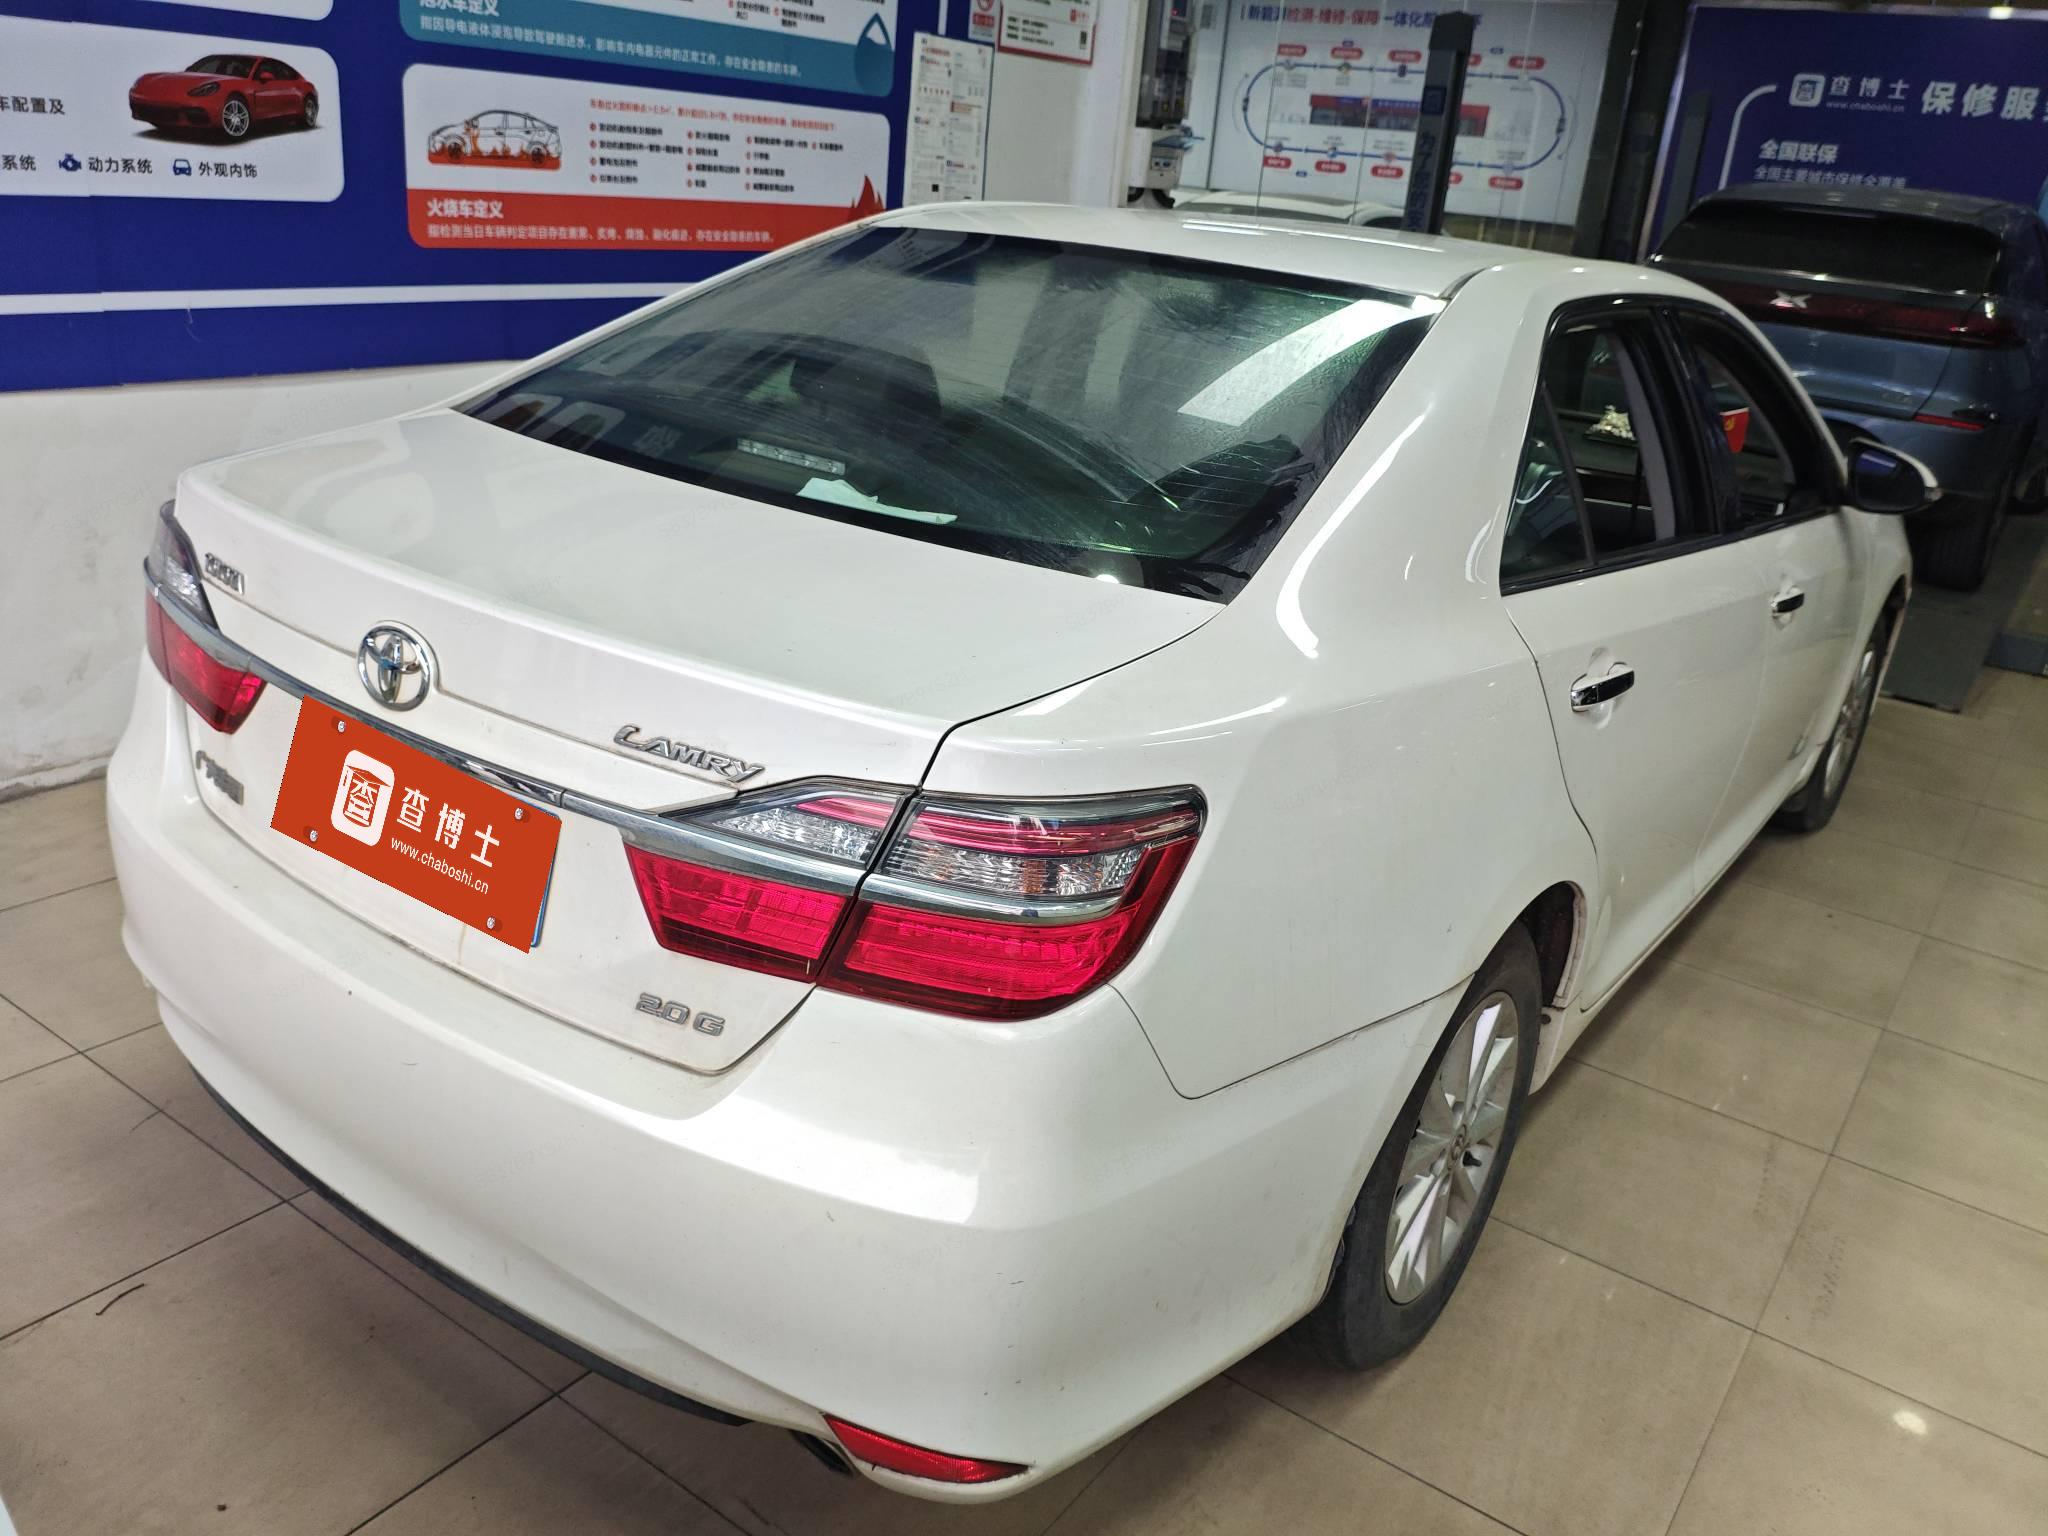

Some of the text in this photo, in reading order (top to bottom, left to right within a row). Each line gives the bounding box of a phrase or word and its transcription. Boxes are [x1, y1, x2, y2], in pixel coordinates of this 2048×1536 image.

[1829, 76, 1910, 100] 查博士
[1921, 80, 2048, 122] 保修服
[1758, 138, 1838, 164] 全国联保
[87, 157, 154, 176] 动力系统
[197, 161, 259, 179] 外观内饰
[427, 199, 504, 219] 火烧车定义
[613, 723, 766, 783] CAMRY
